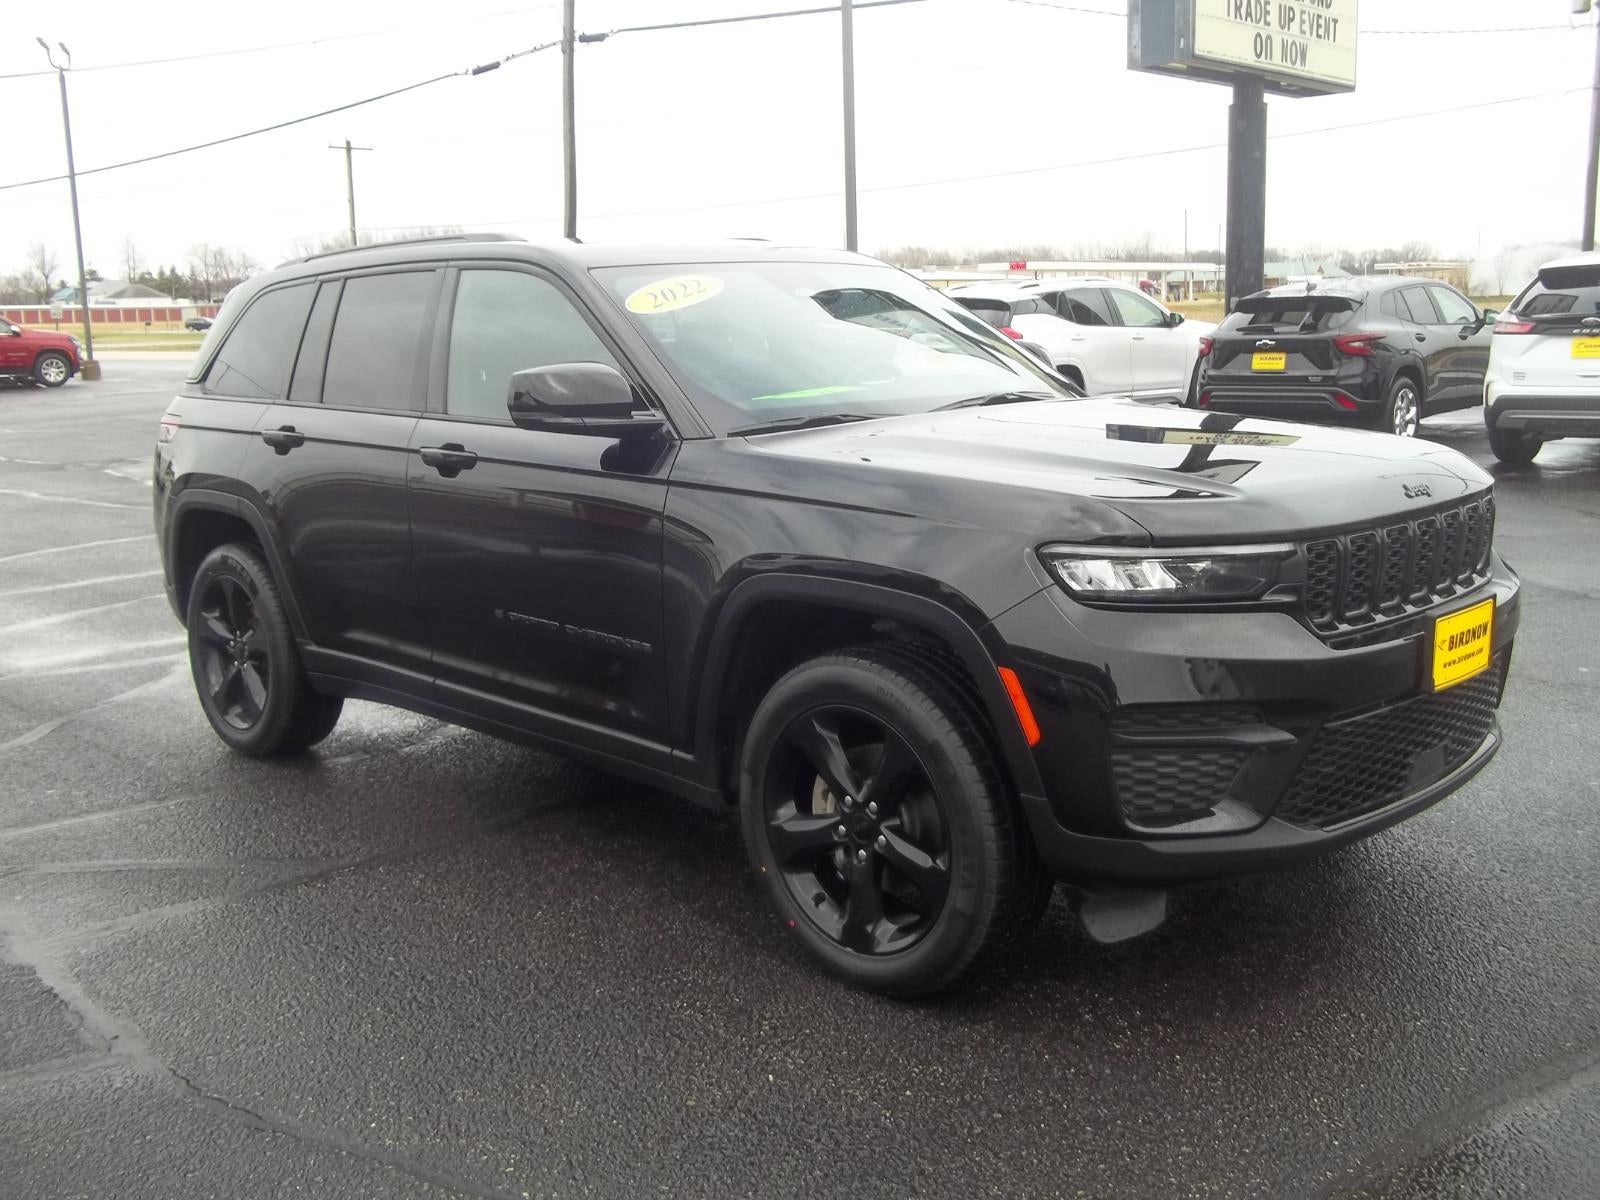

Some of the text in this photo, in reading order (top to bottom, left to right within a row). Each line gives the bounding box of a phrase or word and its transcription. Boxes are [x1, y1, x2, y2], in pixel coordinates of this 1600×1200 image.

[1225, 0, 1339, 43] TRADE UP EVENT
[1281, 37, 1308, 68] NOW
[646, 279, 707, 308] 2022
[1448, 620, 1489, 651] BIRDNOW
